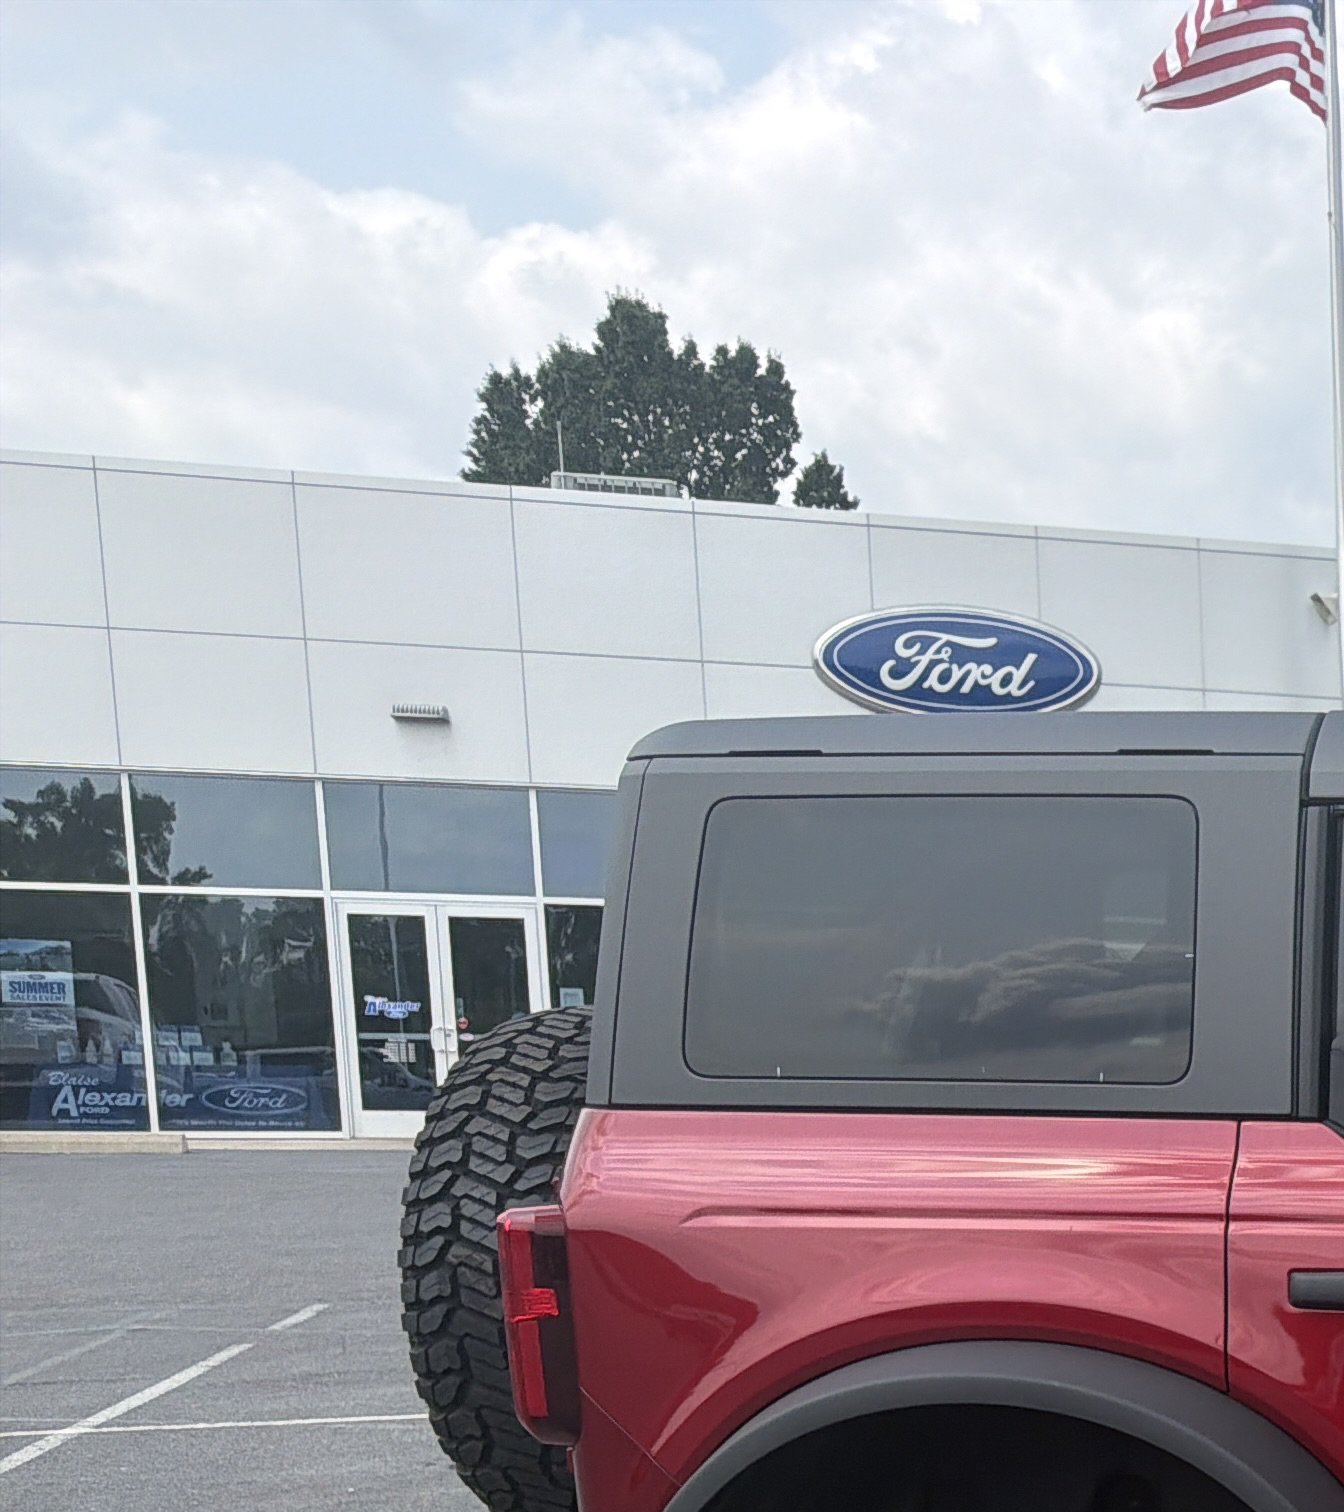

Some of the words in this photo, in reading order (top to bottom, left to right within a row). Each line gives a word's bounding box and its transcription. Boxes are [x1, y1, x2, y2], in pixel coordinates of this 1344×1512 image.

[880, 630, 1039, 698] Ford
[9, 981, 66, 995] SUMMER
[48, 1071, 99, 1086] Blaise
[224, 1087, 288, 1108] Ford
[79, 1106, 110, 1115] FORD
